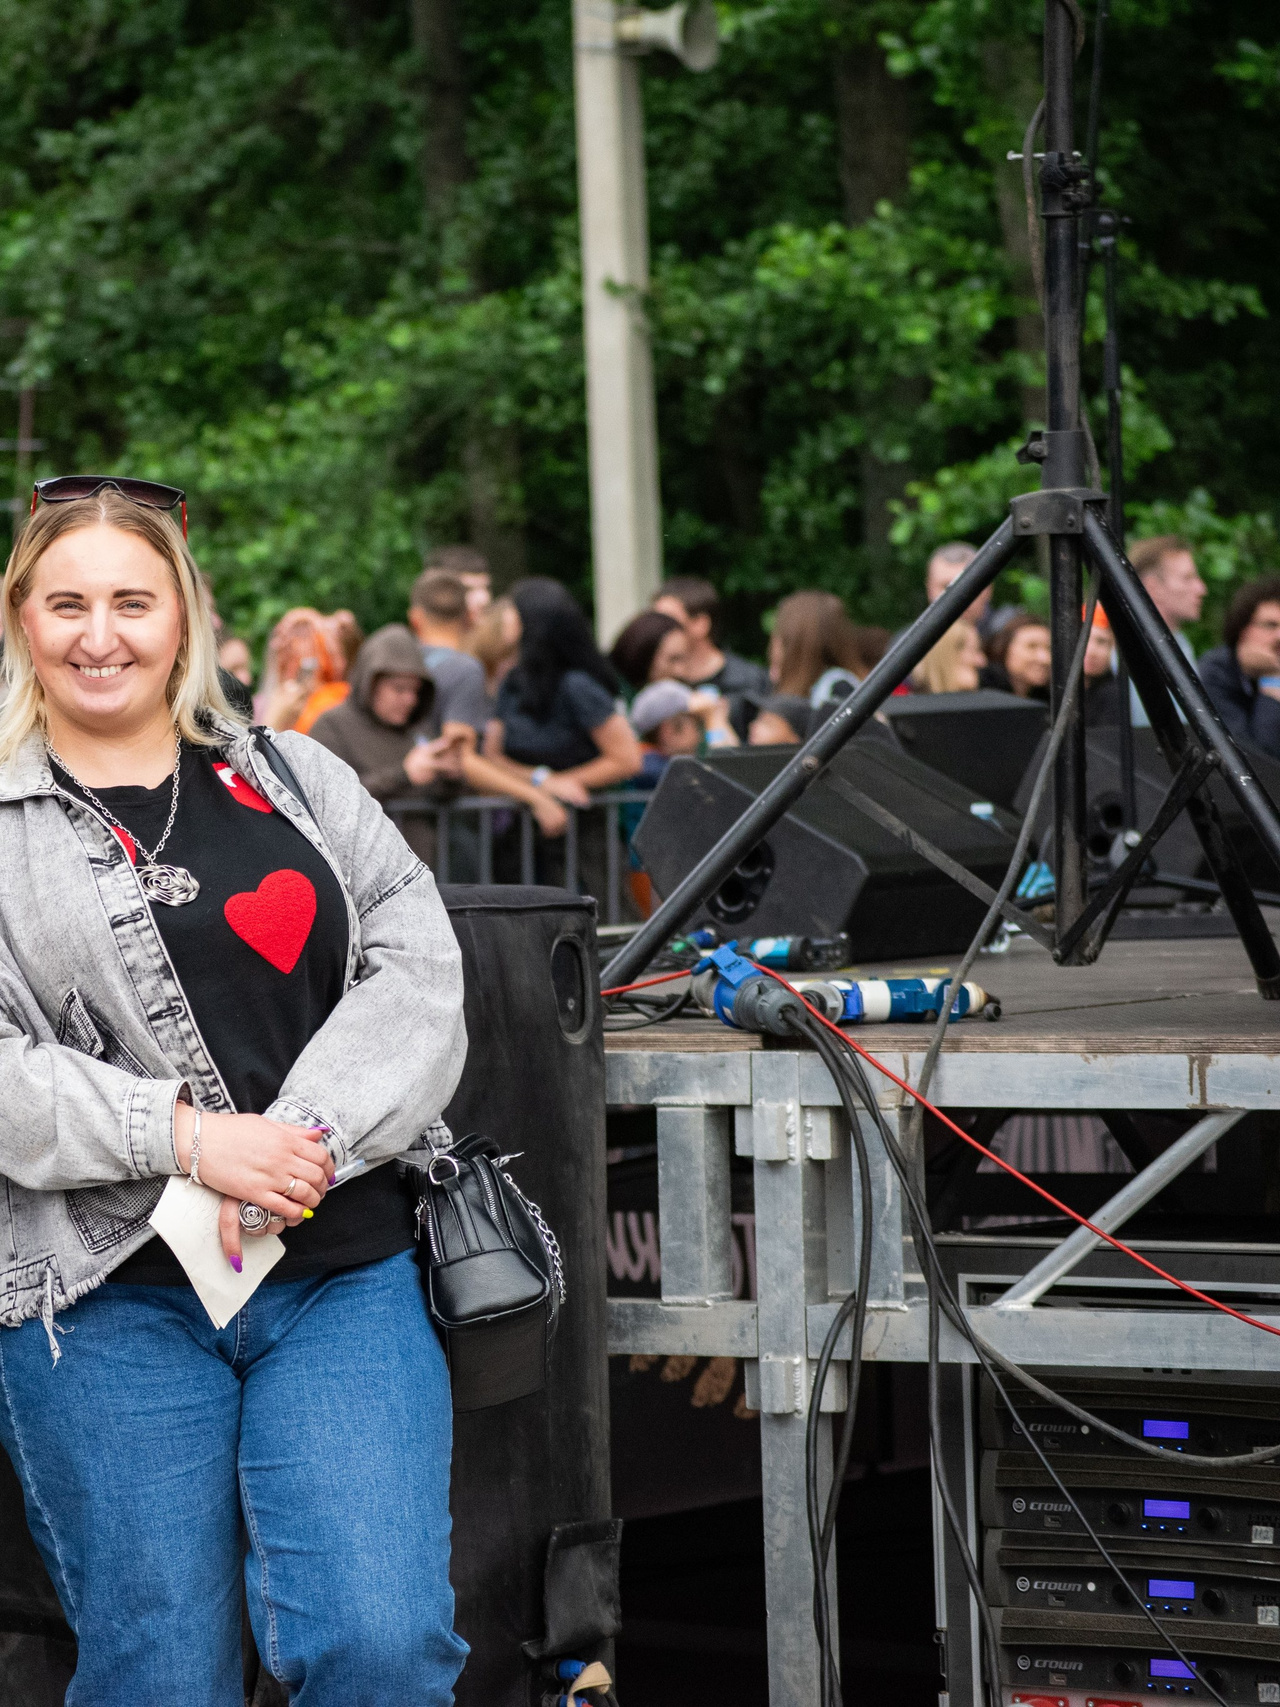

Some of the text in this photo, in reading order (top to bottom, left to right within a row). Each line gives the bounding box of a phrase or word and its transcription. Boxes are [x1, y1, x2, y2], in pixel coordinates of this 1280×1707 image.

[1028, 1422, 1078, 1434] crown
[1033, 1579, 1083, 1592] crown
[1033, 1658, 1084, 1671] crown
